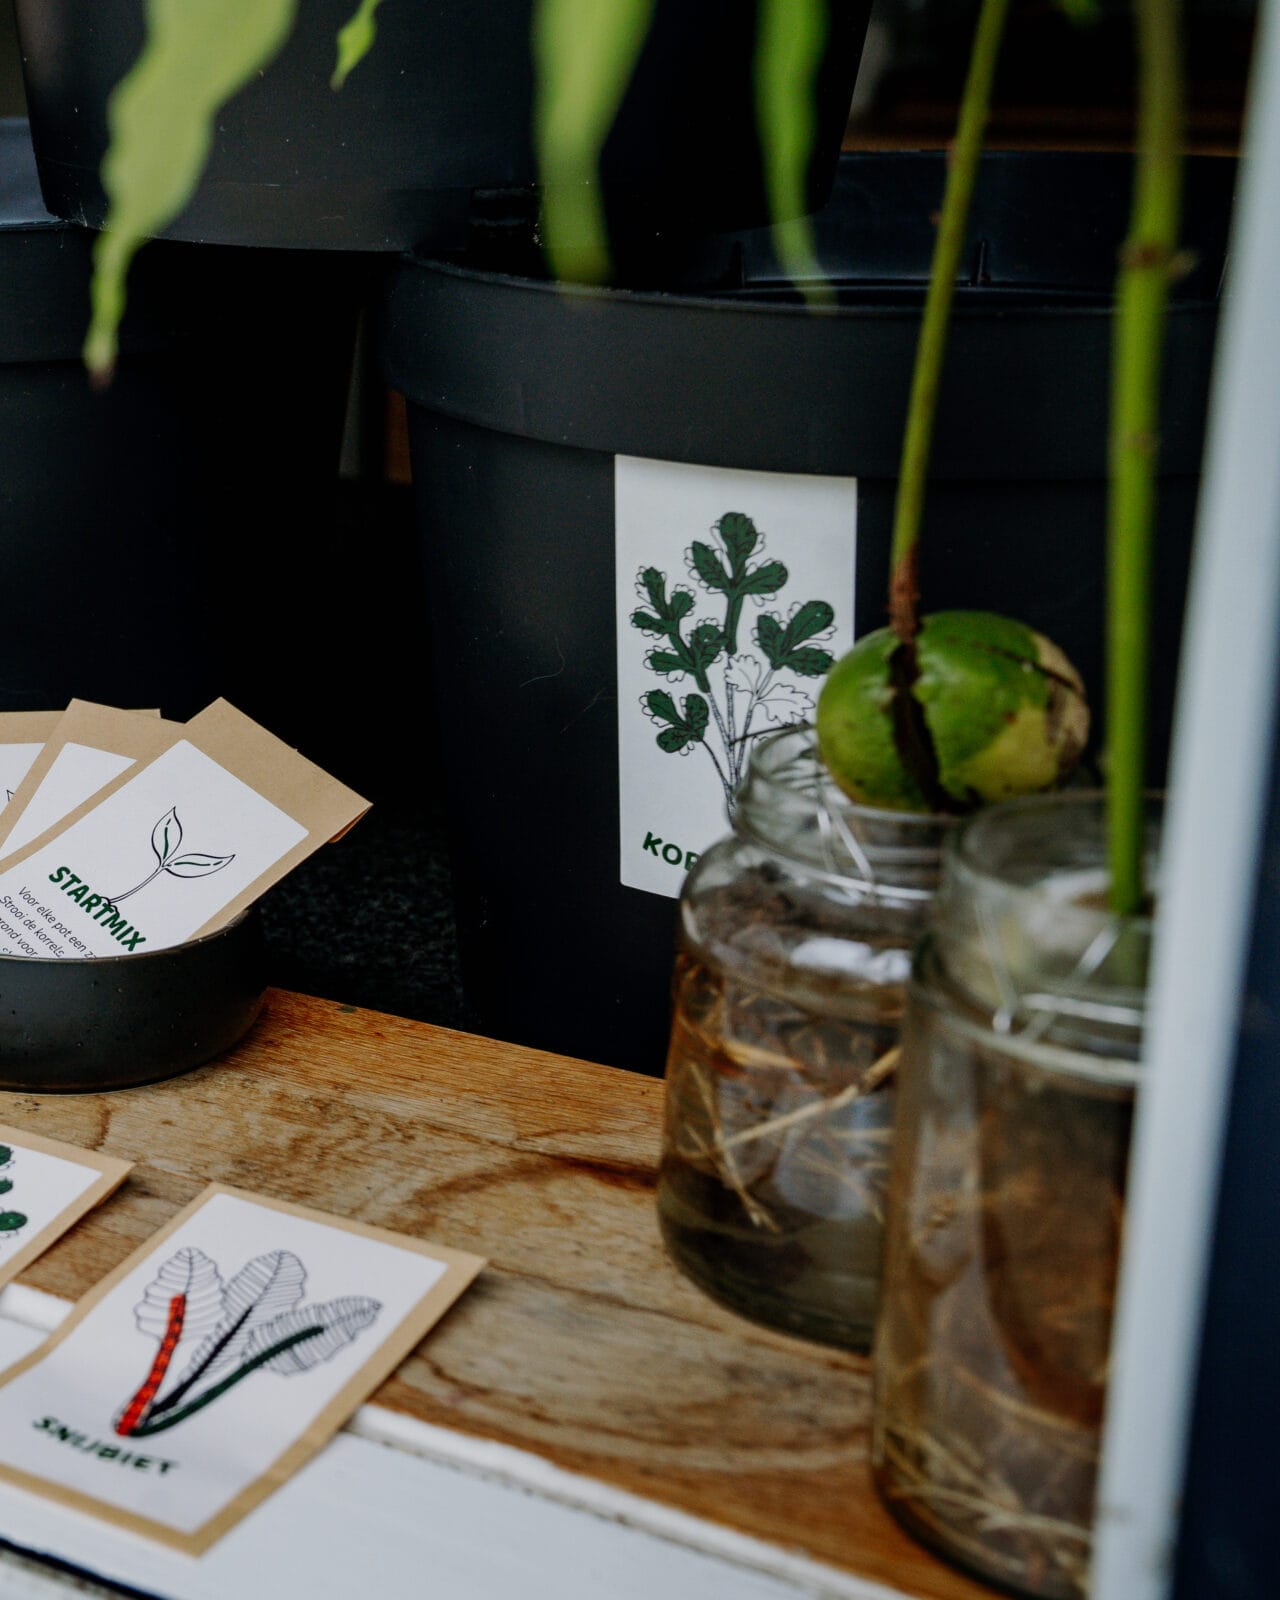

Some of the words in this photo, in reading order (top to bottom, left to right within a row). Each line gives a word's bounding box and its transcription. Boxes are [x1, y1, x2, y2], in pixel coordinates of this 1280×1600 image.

[0, 895, 29, 920] Strooi
[22, 918, 37, 932] de
[18, 886, 40, 908] Voor
[36, 902, 56, 924] elke
[51, 921, 73, 939] pot
[68, 935, 88, 952] een
[48, 866, 146, 952] STARTMIX
[18, 939, 38, 958] voor
[33, 1416, 177, 1475] SNIJBIET
